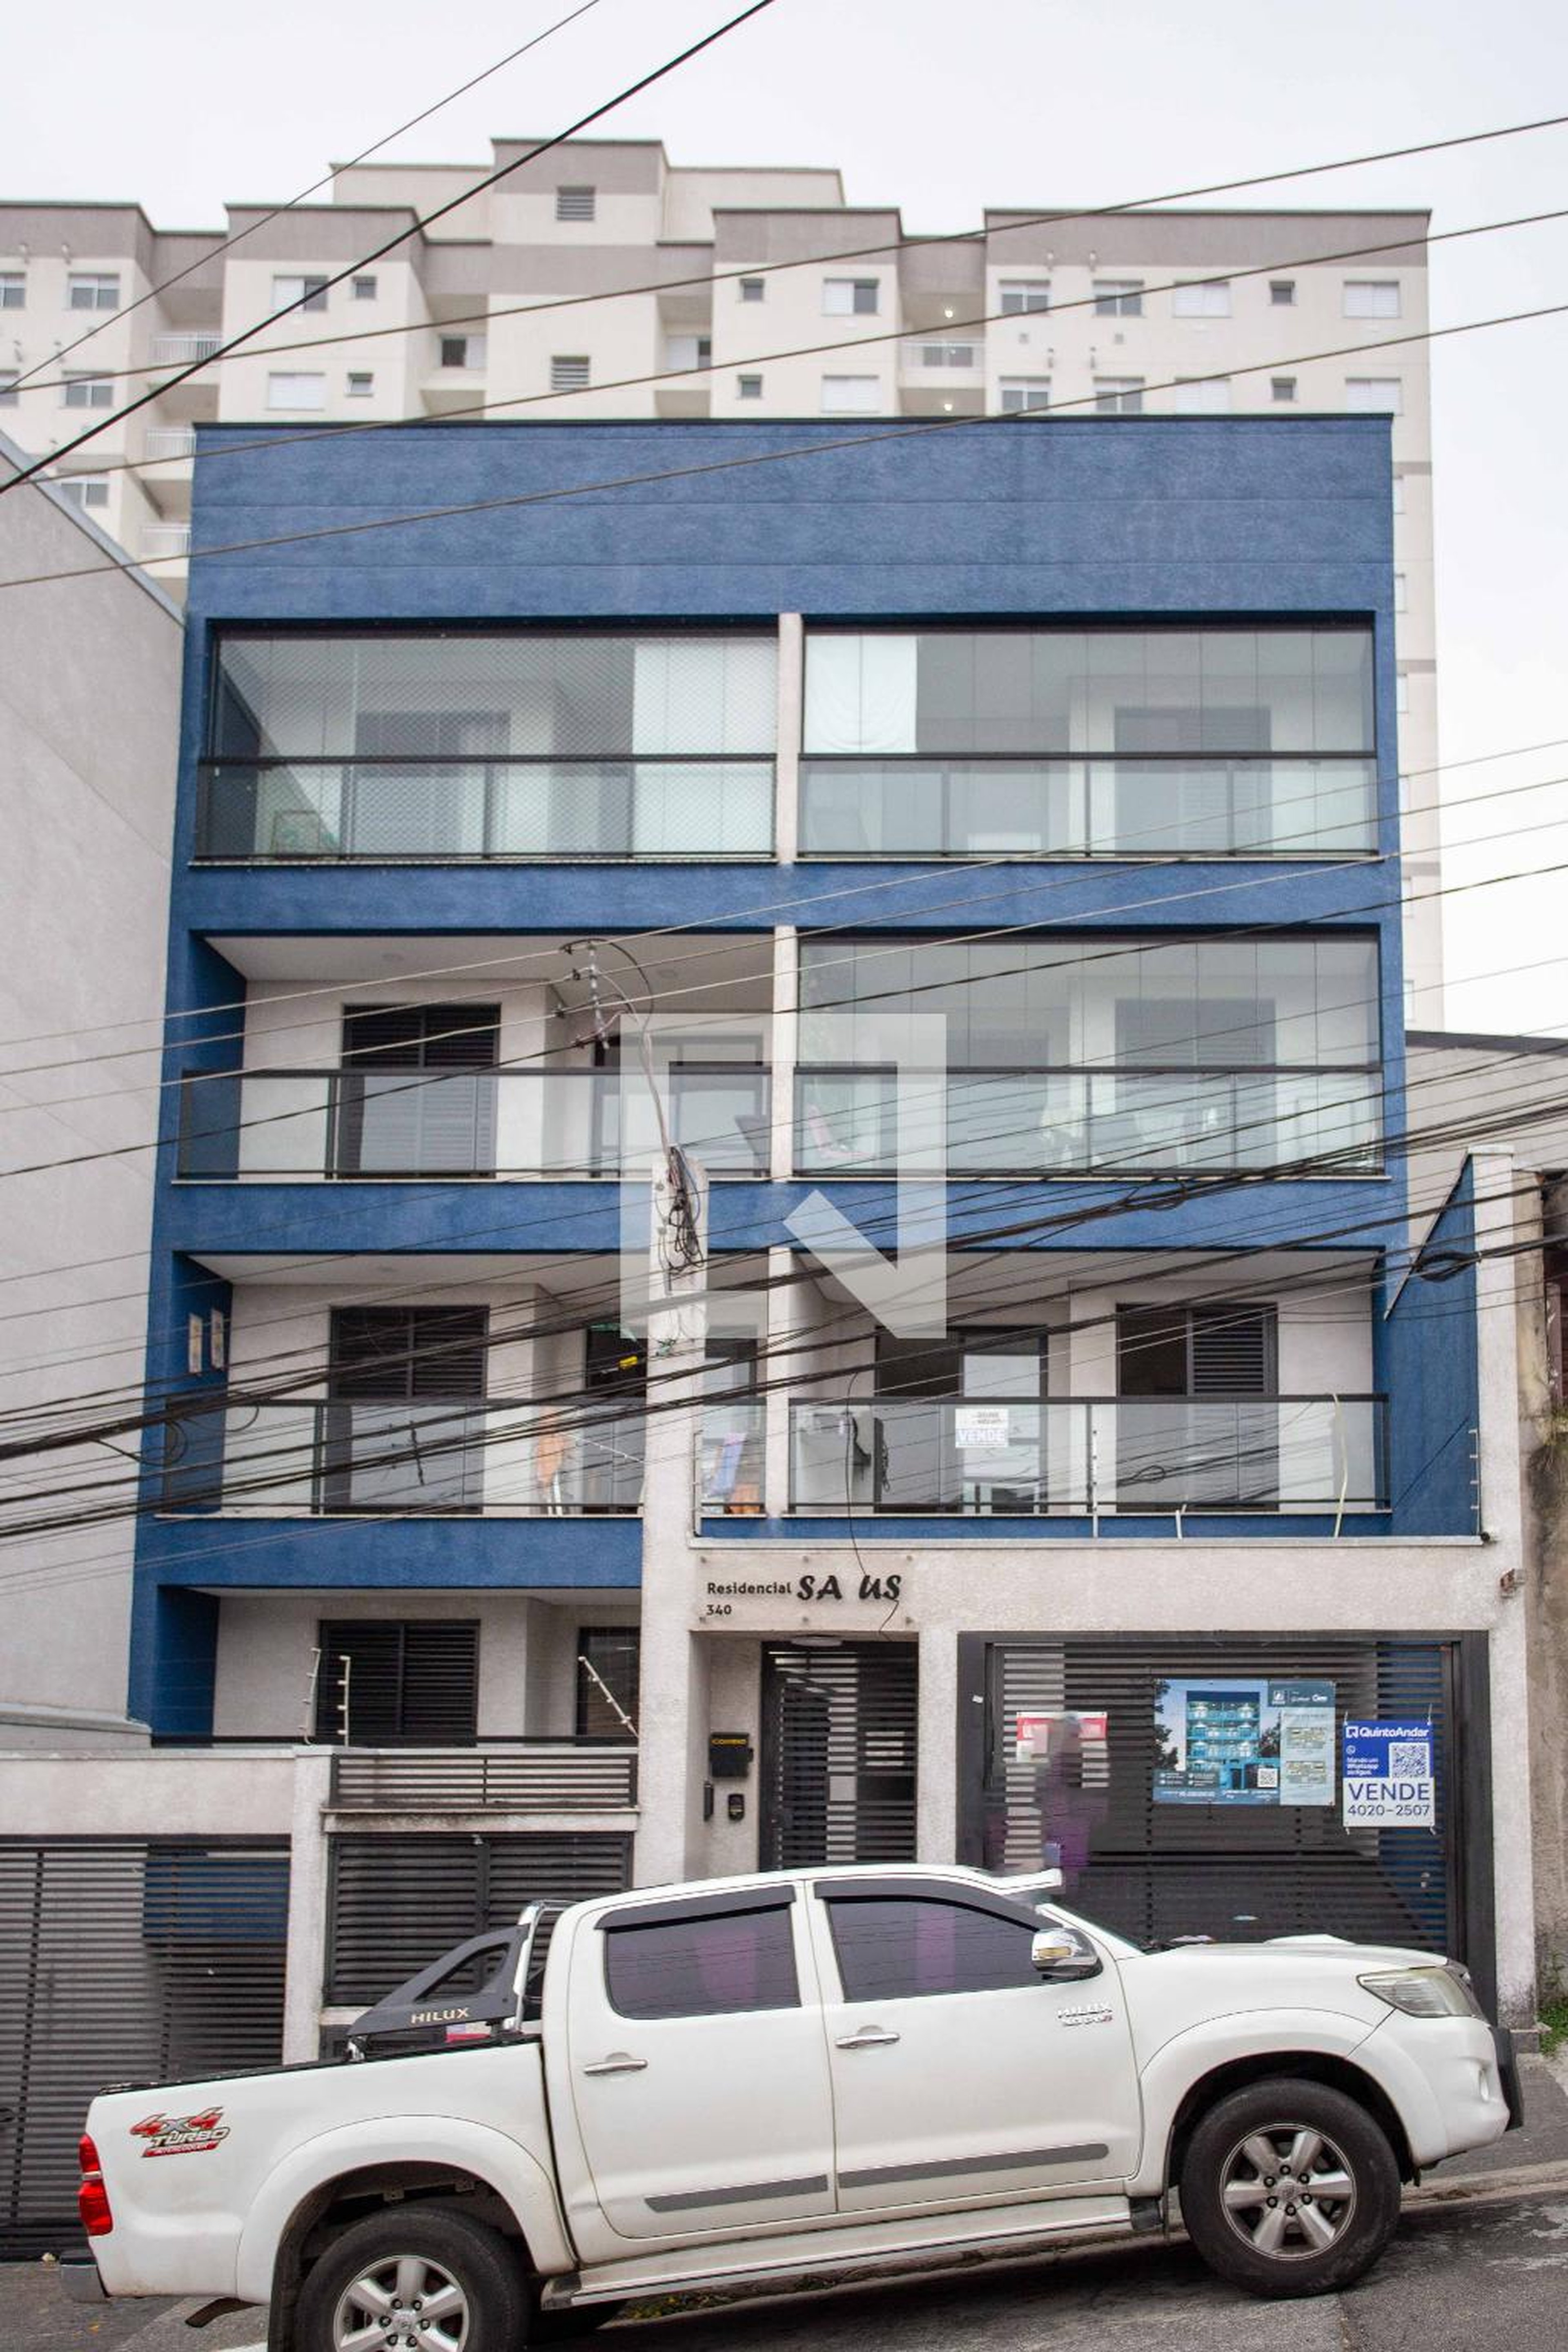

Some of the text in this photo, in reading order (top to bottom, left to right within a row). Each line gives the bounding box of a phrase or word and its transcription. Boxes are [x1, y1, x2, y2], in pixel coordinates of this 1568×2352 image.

[958, 1429, 1005, 1442] VENDE
[707, 1582, 791, 1594] Residencial
[706, 1604, 732, 1616] 340
[1359, 1727, 1429, 1737] QuintoAndar
[1348, 1783, 1430, 1800] VENDE
[1348, 1804, 1430, 1816] 4020-2507
[411, 2007, 469, 2024] HILUX
[151, 2126, 231, 2148] TURBO
